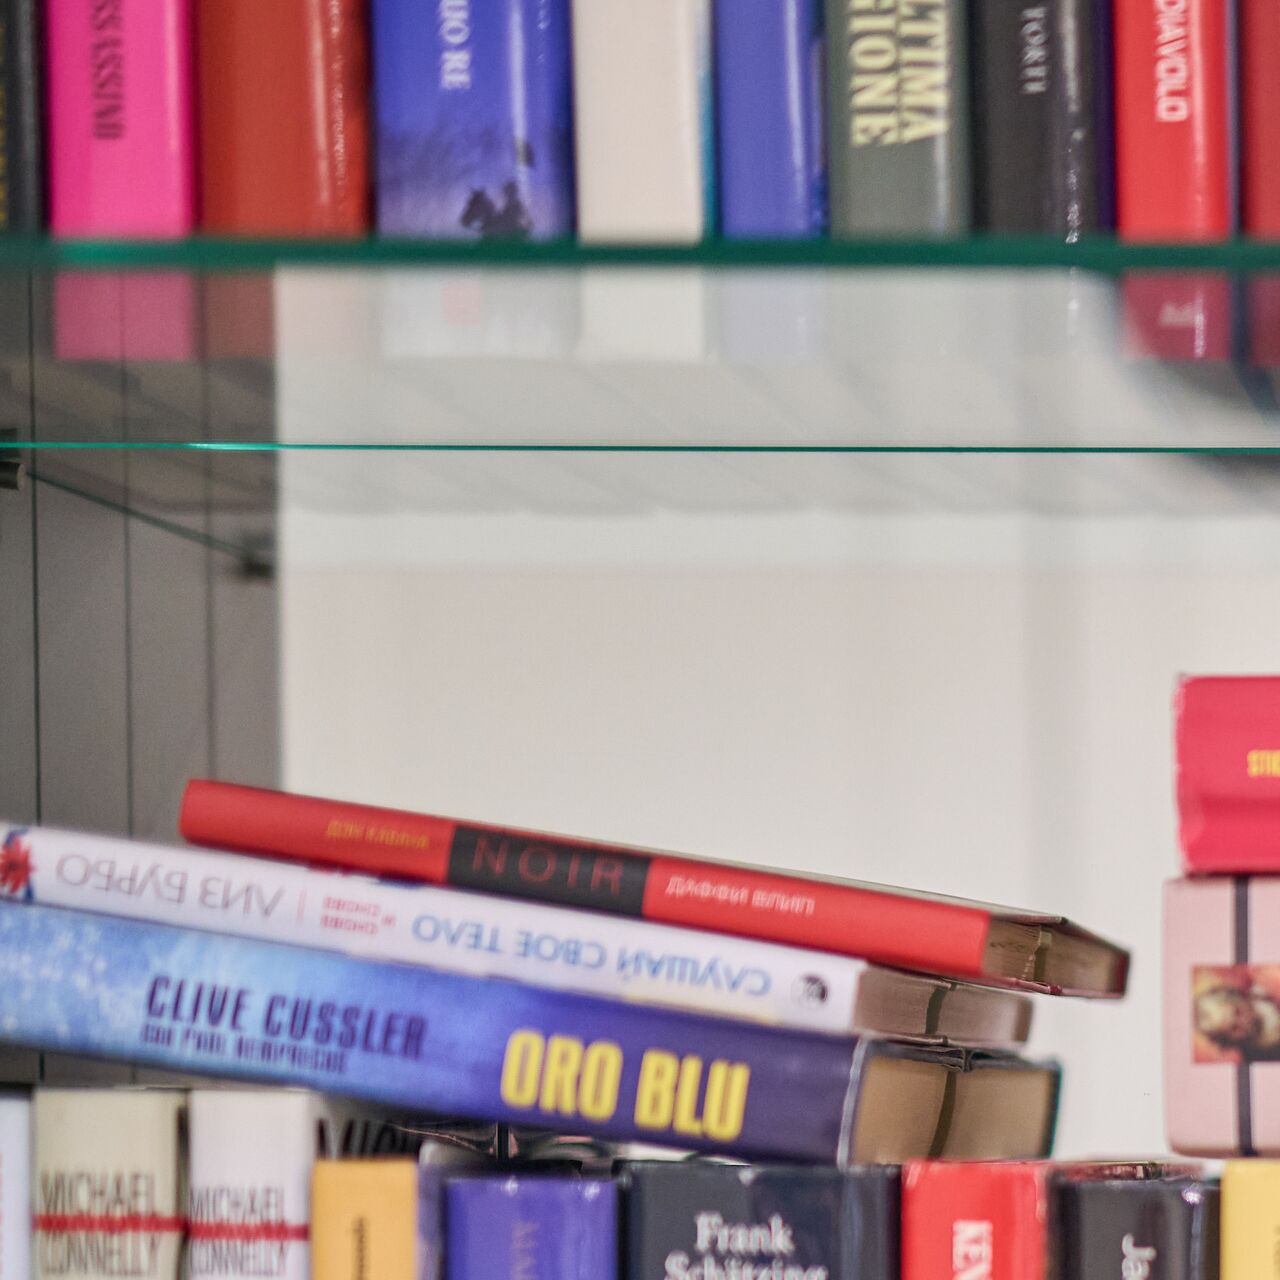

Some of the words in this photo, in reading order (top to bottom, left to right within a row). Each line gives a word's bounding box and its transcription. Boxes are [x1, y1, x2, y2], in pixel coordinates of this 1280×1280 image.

[55, 852, 191, 906] БУРБО
[471, 835, 624, 898] NOIR
[200, 875, 288, 919] ЛИЗ
[411, 913, 502, 954] ТЕЛО
[515, 929, 606, 970] СВОЕ
[617, 946, 772, 998] СЛУШАЙ
[146, 974, 249, 1031] CLIVE
[263, 993, 430, 1060] CUSSLER
[501, 1028, 624, 1123] ORO
[634, 1048, 751, 1142] BLU
[695, 1211, 794, 1255] Frank
